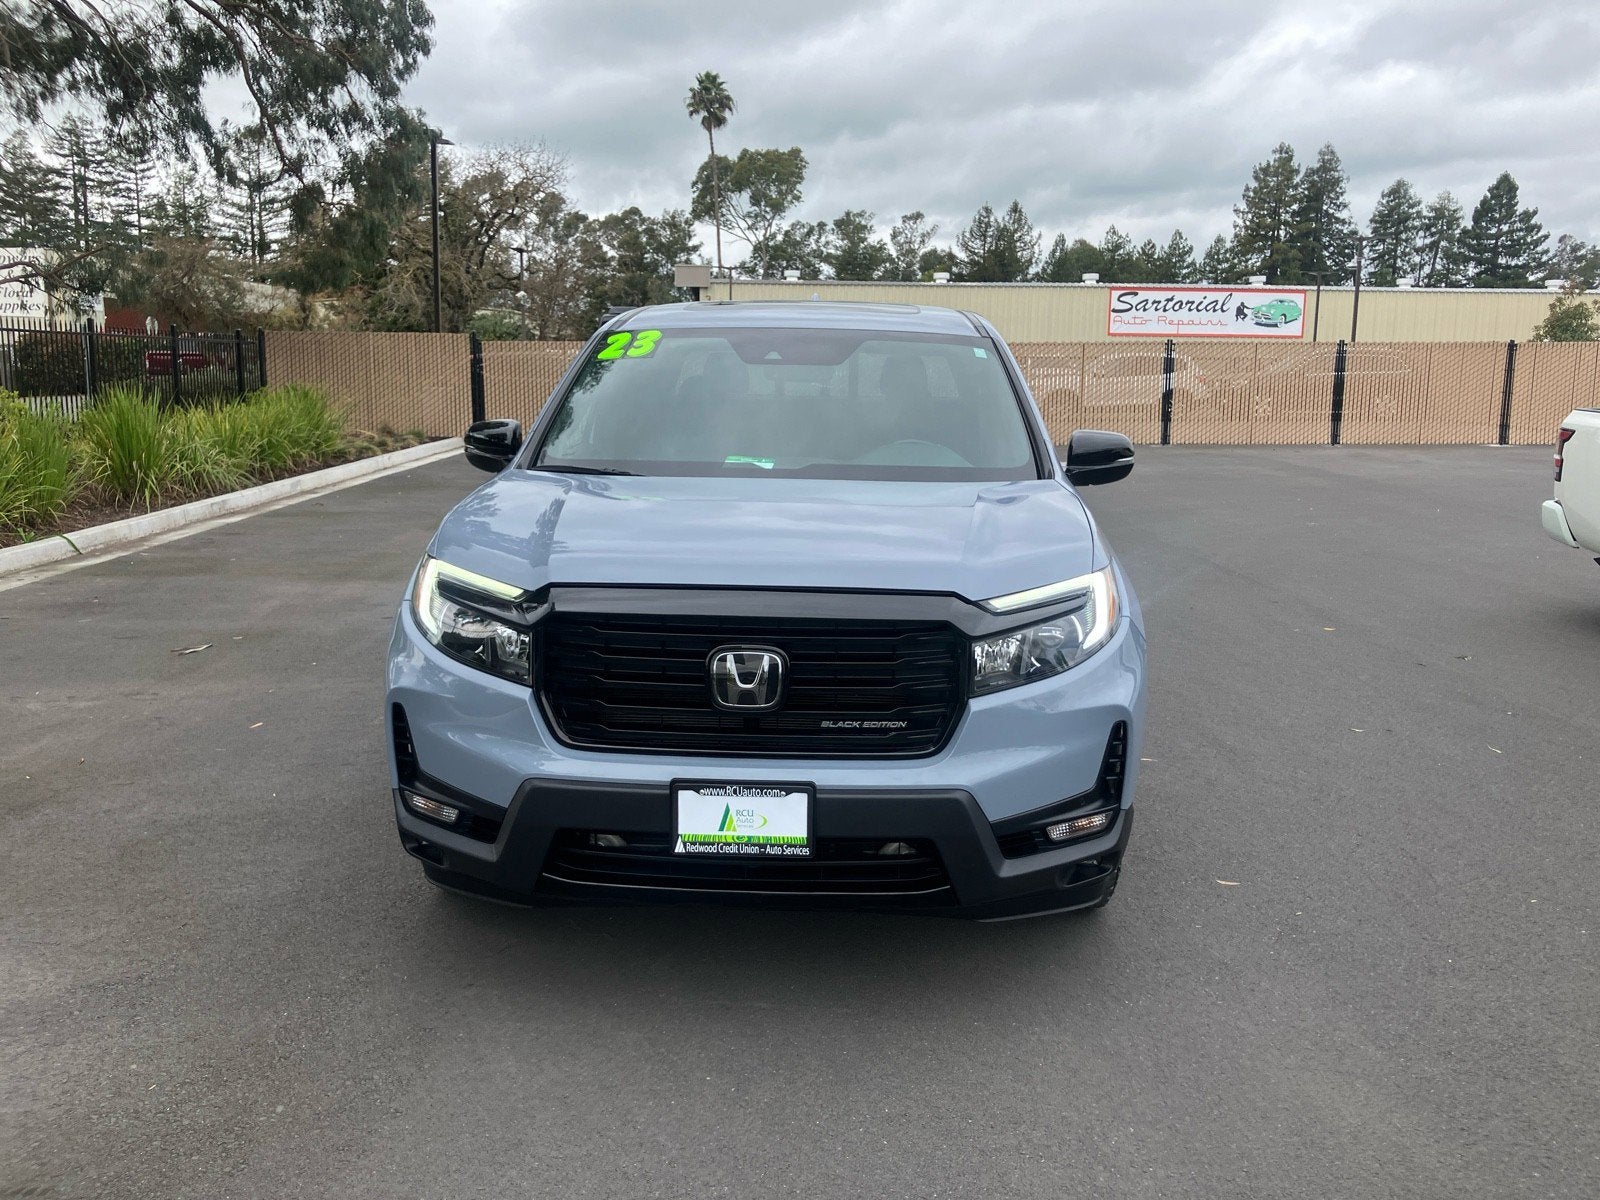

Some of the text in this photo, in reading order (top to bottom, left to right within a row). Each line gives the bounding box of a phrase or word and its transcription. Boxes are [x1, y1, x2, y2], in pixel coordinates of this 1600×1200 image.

[1111, 291, 1233, 313] Sartorial
[1113, 316, 1228, 333] Auto Repairs
[597, 330, 663, 360] 23
[703, 786, 780, 797] www.RCUauto.com
[736, 809, 754, 817] RCU
[686, 842, 718, 853] Redwood
[718, 843, 739, 853] Credit
[739, 844, 760, 854] Union
[766, 844, 782, 855] Auto
[783, 845, 810, 856] Services
